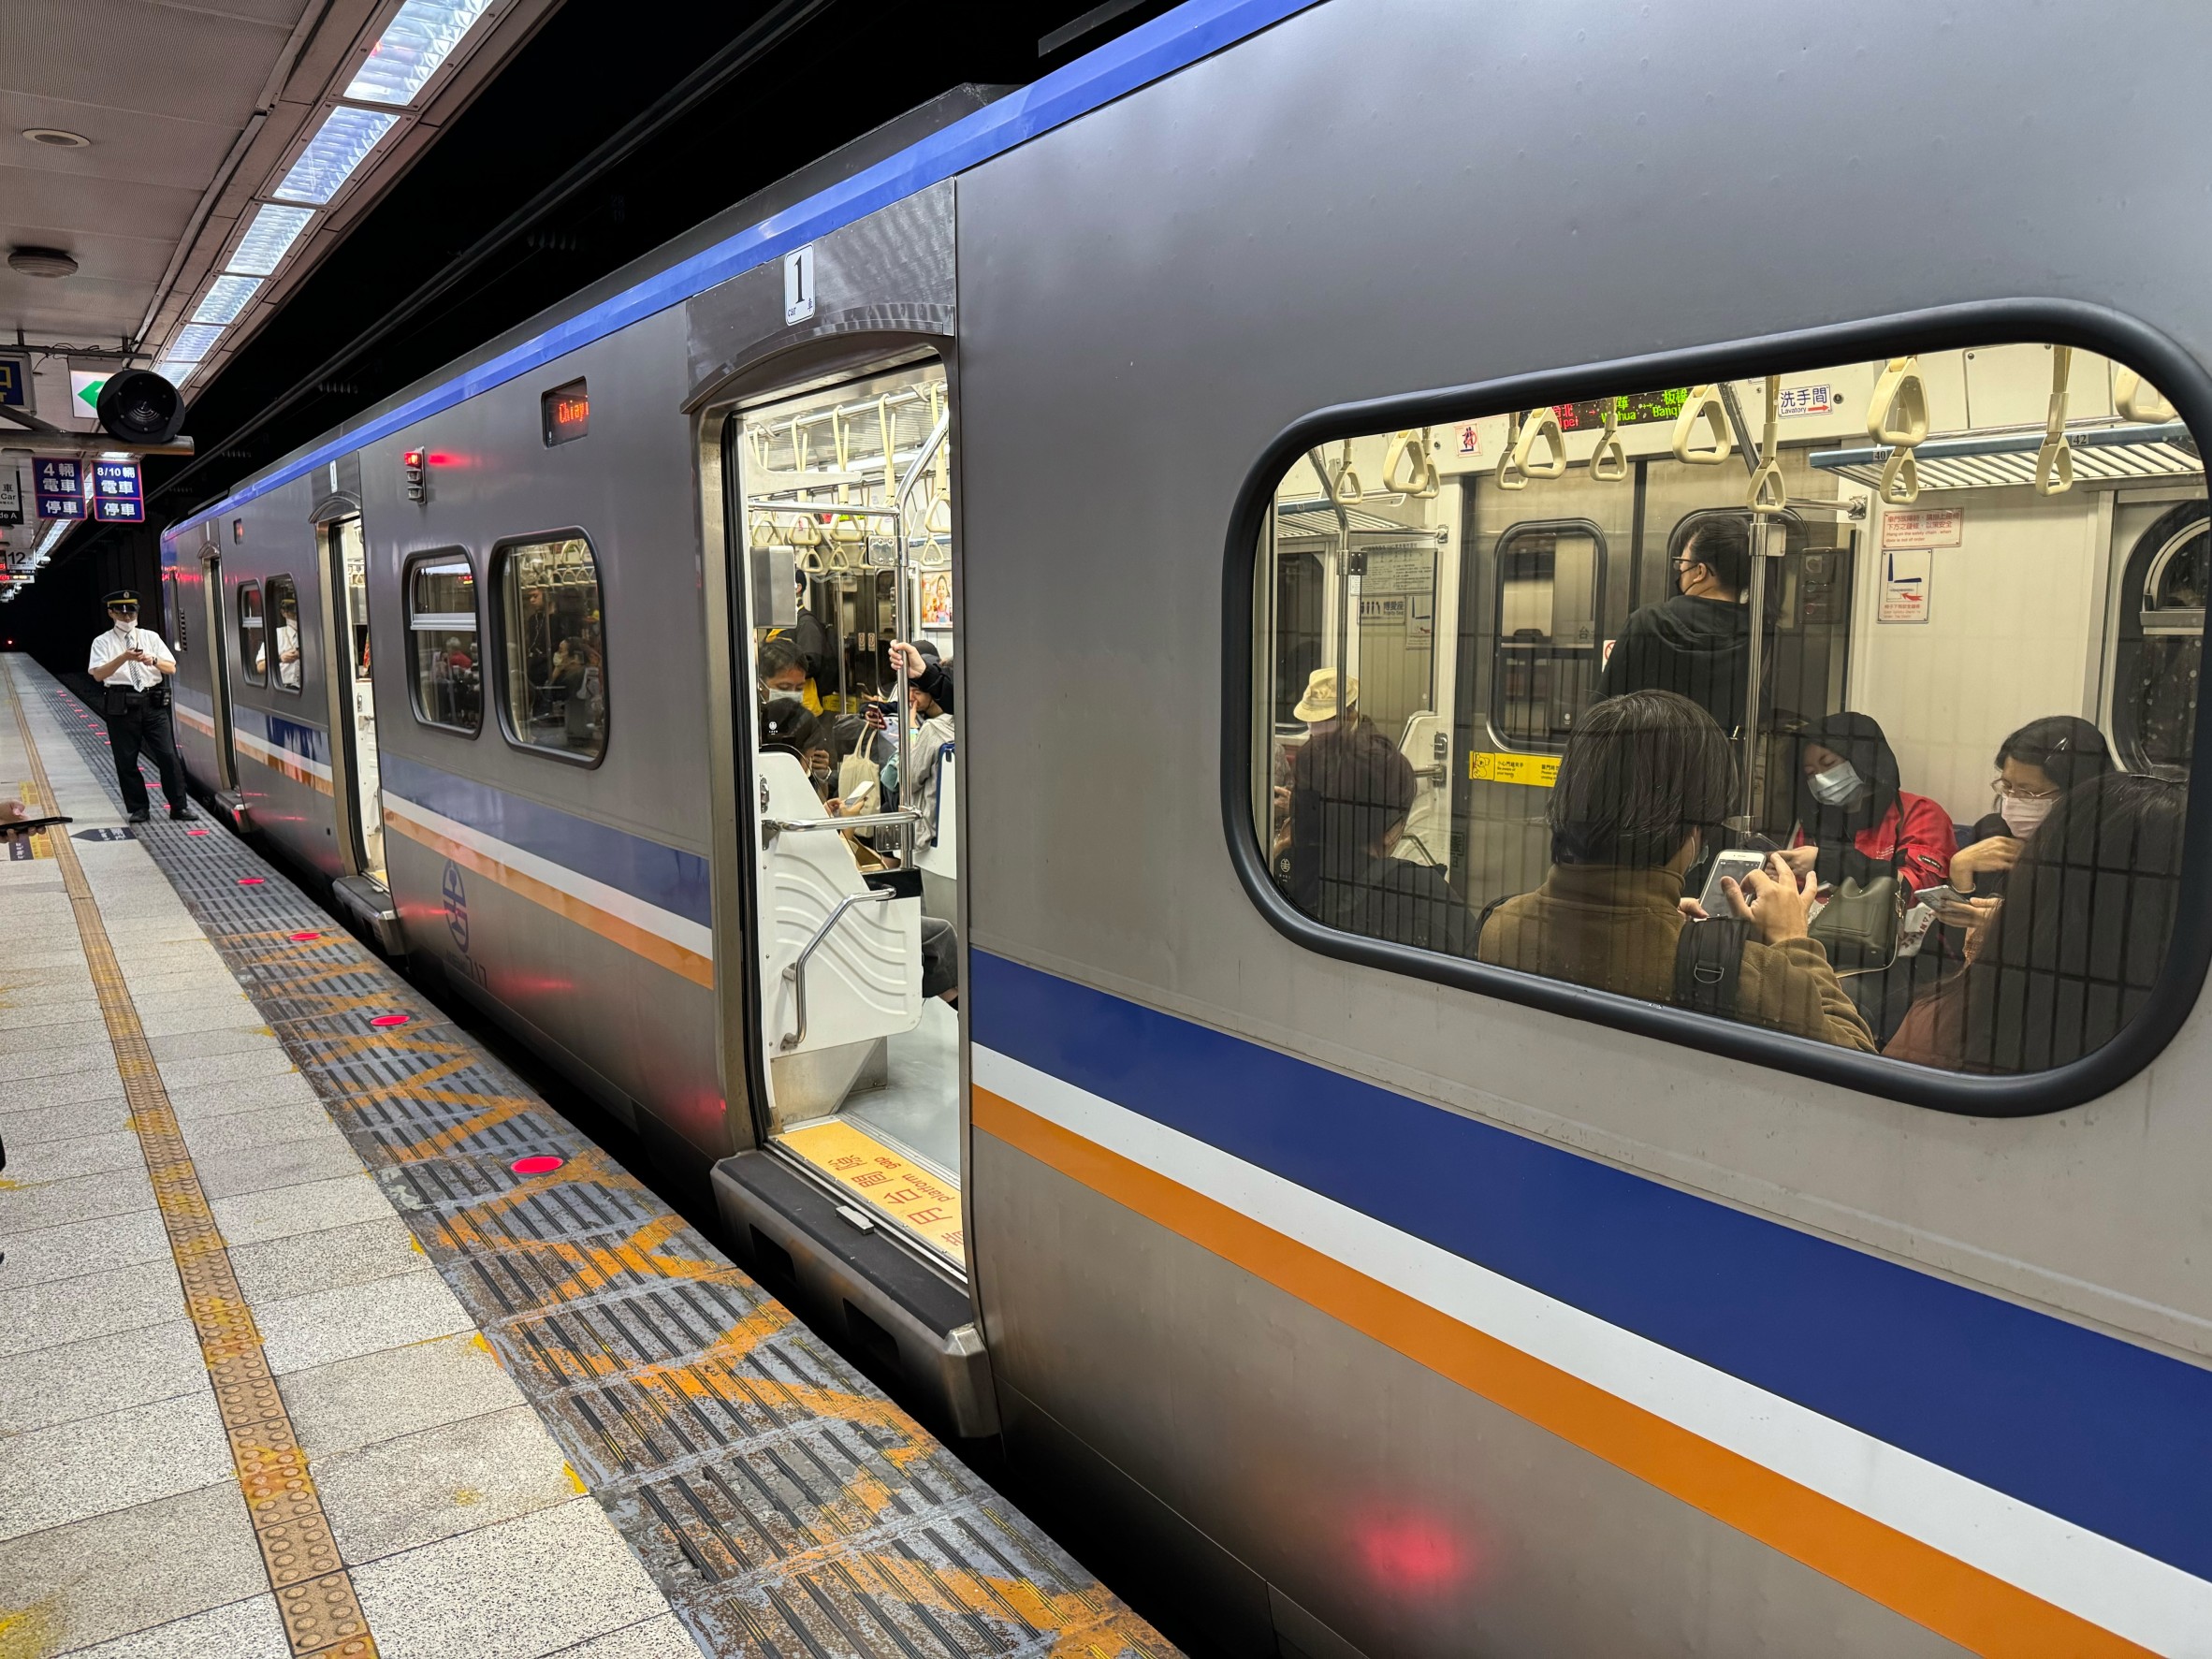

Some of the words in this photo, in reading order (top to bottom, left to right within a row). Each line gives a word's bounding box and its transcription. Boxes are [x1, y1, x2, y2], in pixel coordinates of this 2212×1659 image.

[794, 255, 805, 304] 1
[1781, 387, 1827, 408] 洗手間
[559, 395, 589, 424] Chiayi
[1652, 404, 1681, 420] Banqi
[1560, 418, 1579, 430] ipei
[1601, 411, 1637, 424] Whua
[2073, 434, 2087, 444] 42
[1874, 450, 1886, 460] 40
[42, 478, 77, 493] 電車
[101, 479, 134, 495] 電車
[46, 500, 79, 515] 停車
[104, 502, 136, 517] 停車
[8, 551, 26, 565] 12
[874, 1157, 901, 1170] gap
[901, 1172, 956, 1203] platform
